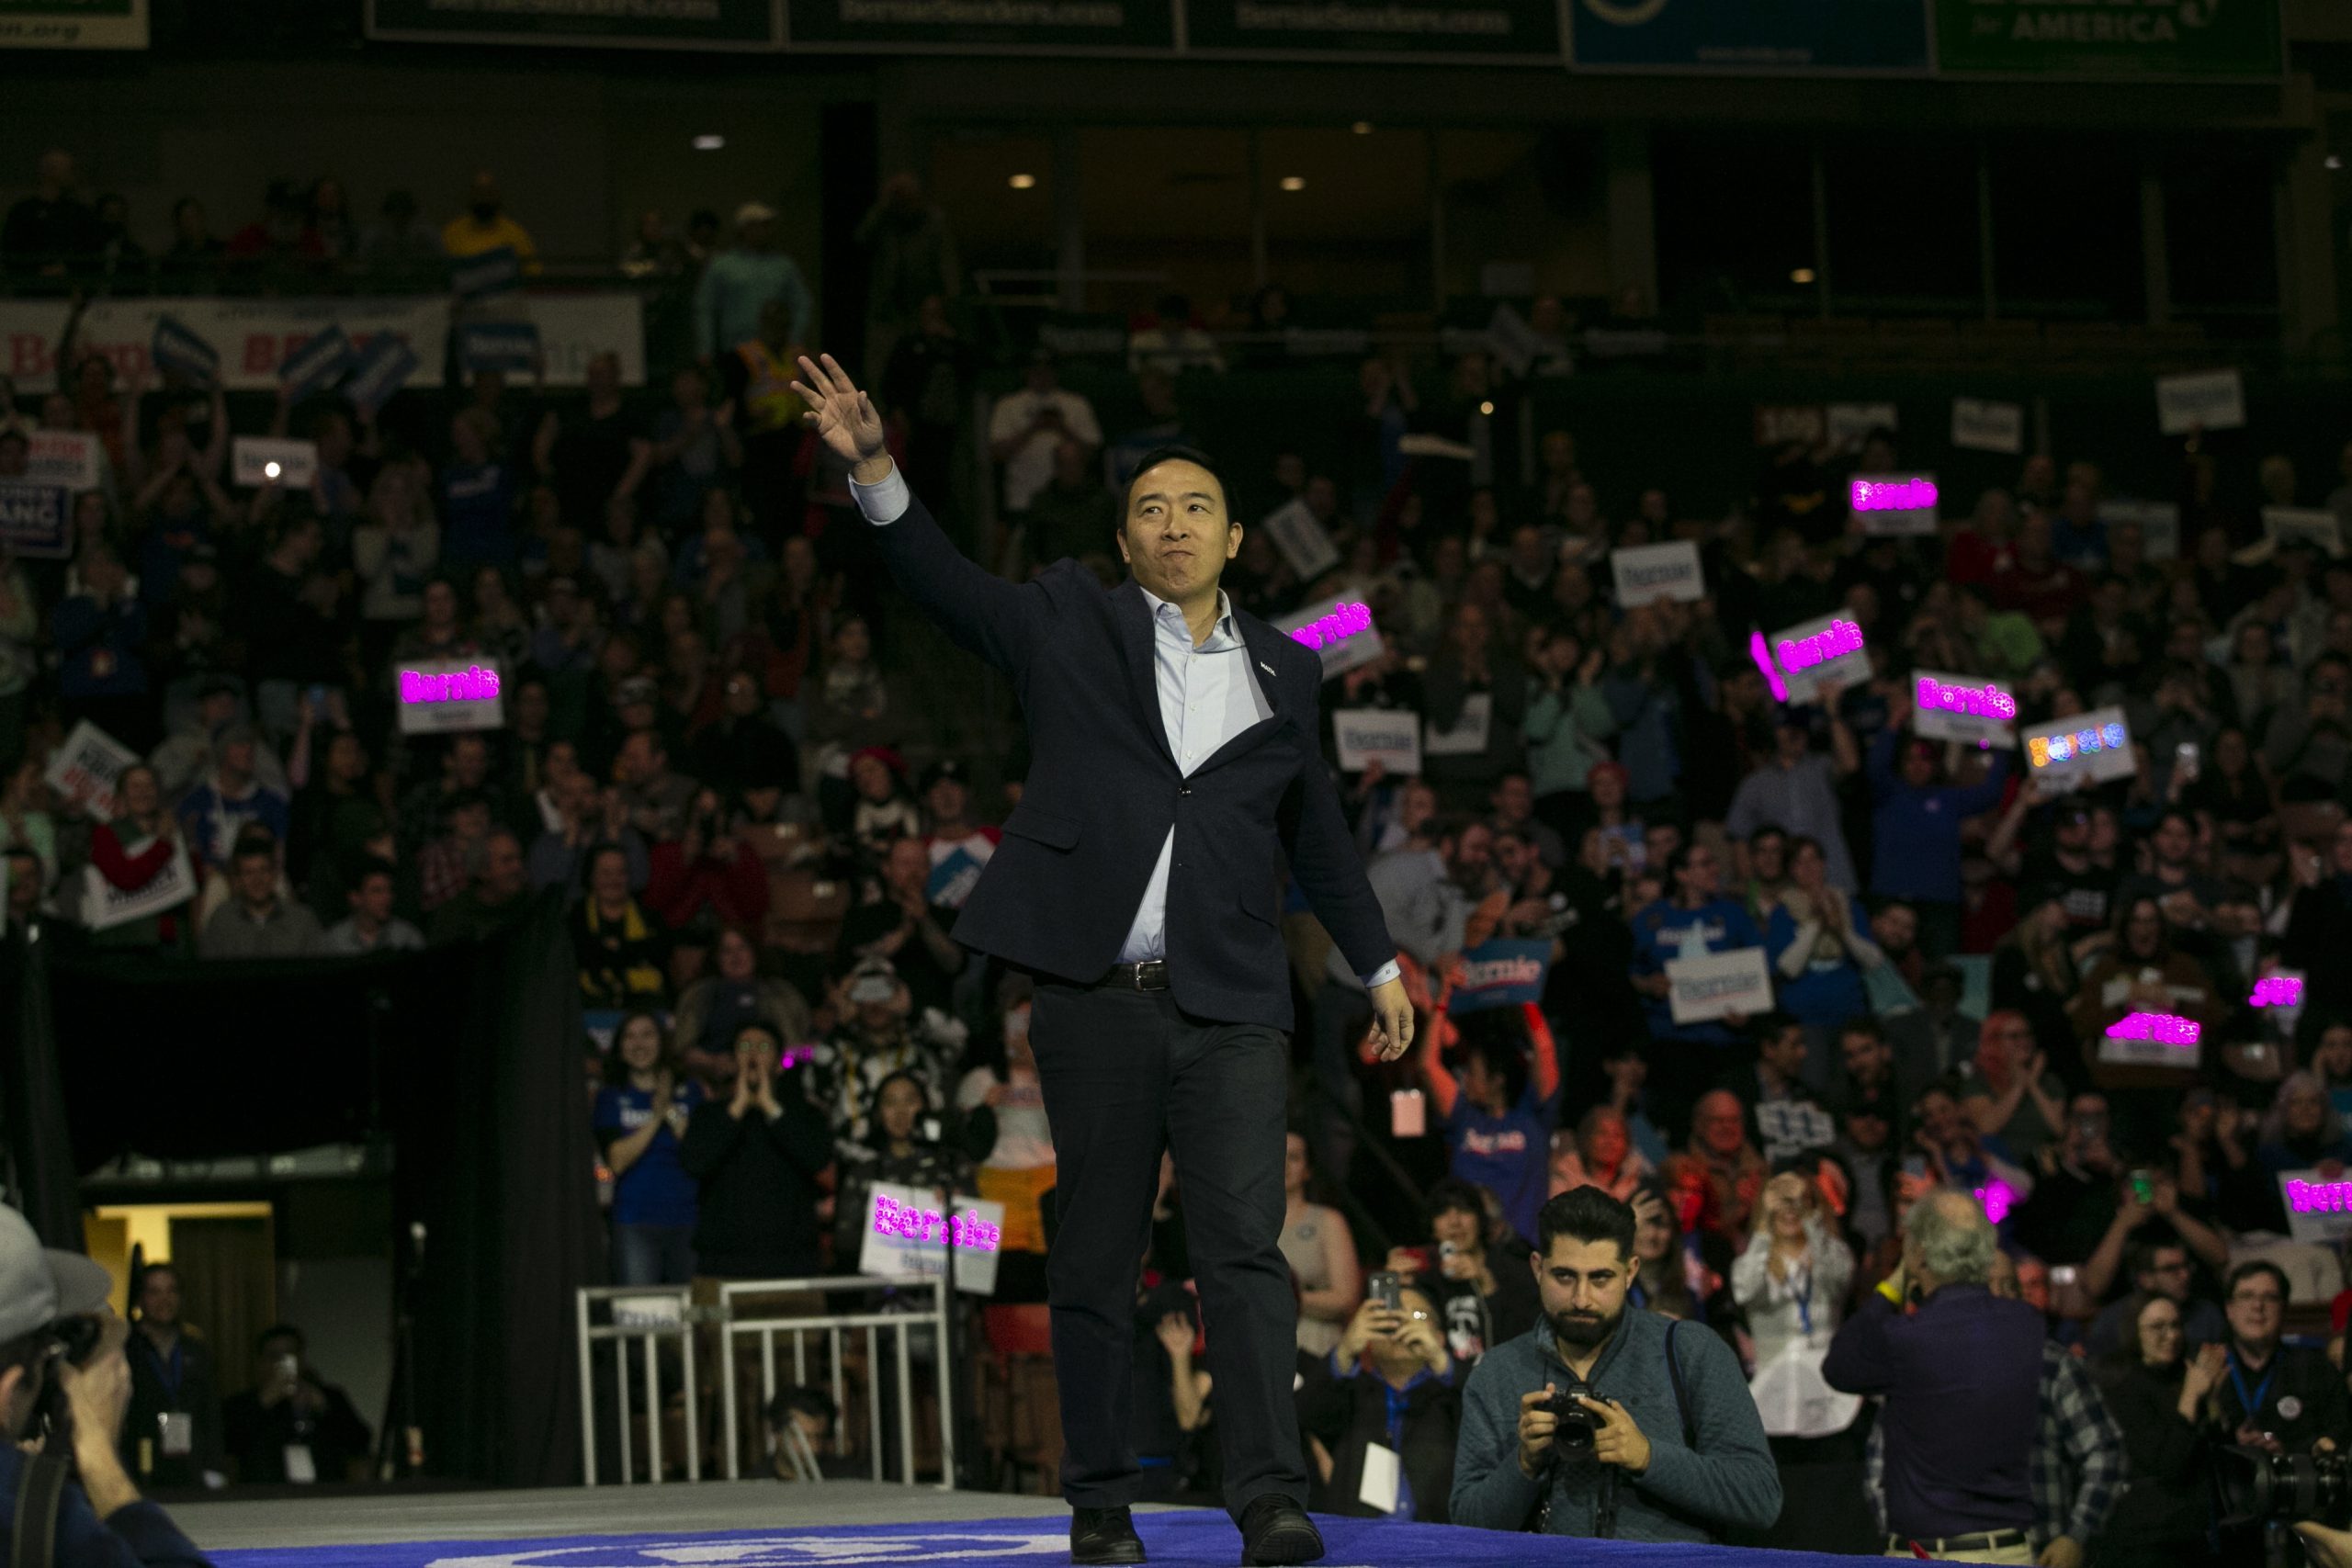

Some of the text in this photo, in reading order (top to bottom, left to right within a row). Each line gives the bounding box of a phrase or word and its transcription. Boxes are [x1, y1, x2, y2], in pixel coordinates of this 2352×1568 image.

[2010, 11, 2176, 43] AMERICA
[401, 665, 499, 703] Bernie
[1917, 678, 2015, 720] Bernie
[876, 1194, 1000, 1250] Bernie
